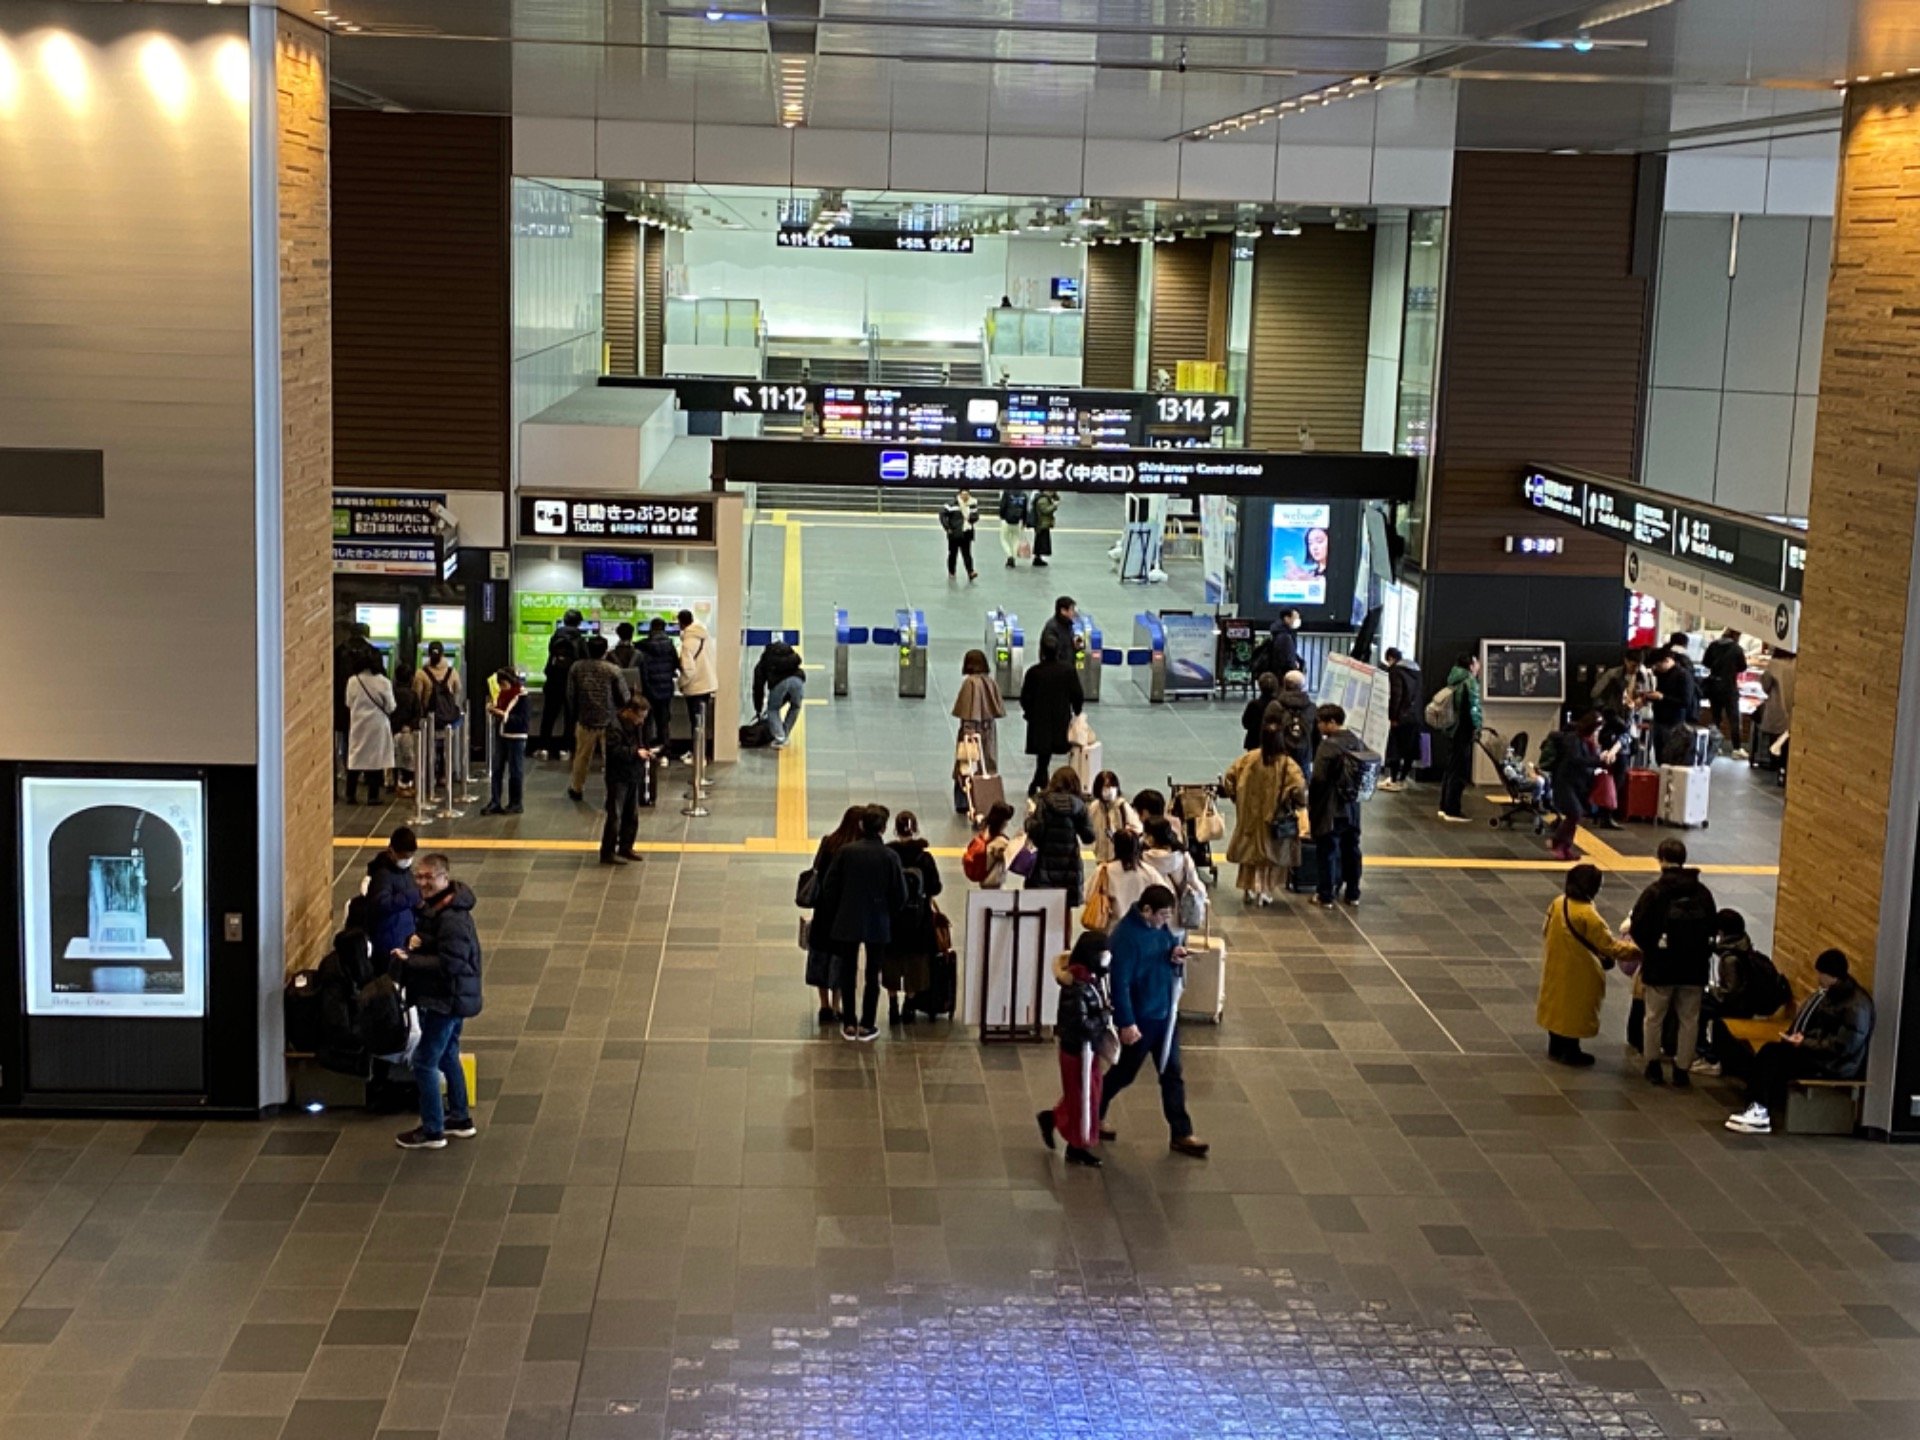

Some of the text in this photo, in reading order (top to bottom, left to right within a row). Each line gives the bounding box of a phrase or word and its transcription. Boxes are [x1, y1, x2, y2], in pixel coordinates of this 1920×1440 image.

[572, 503, 699, 522] 自動きっぷうりば
[573, 520, 605, 533] Tickets
